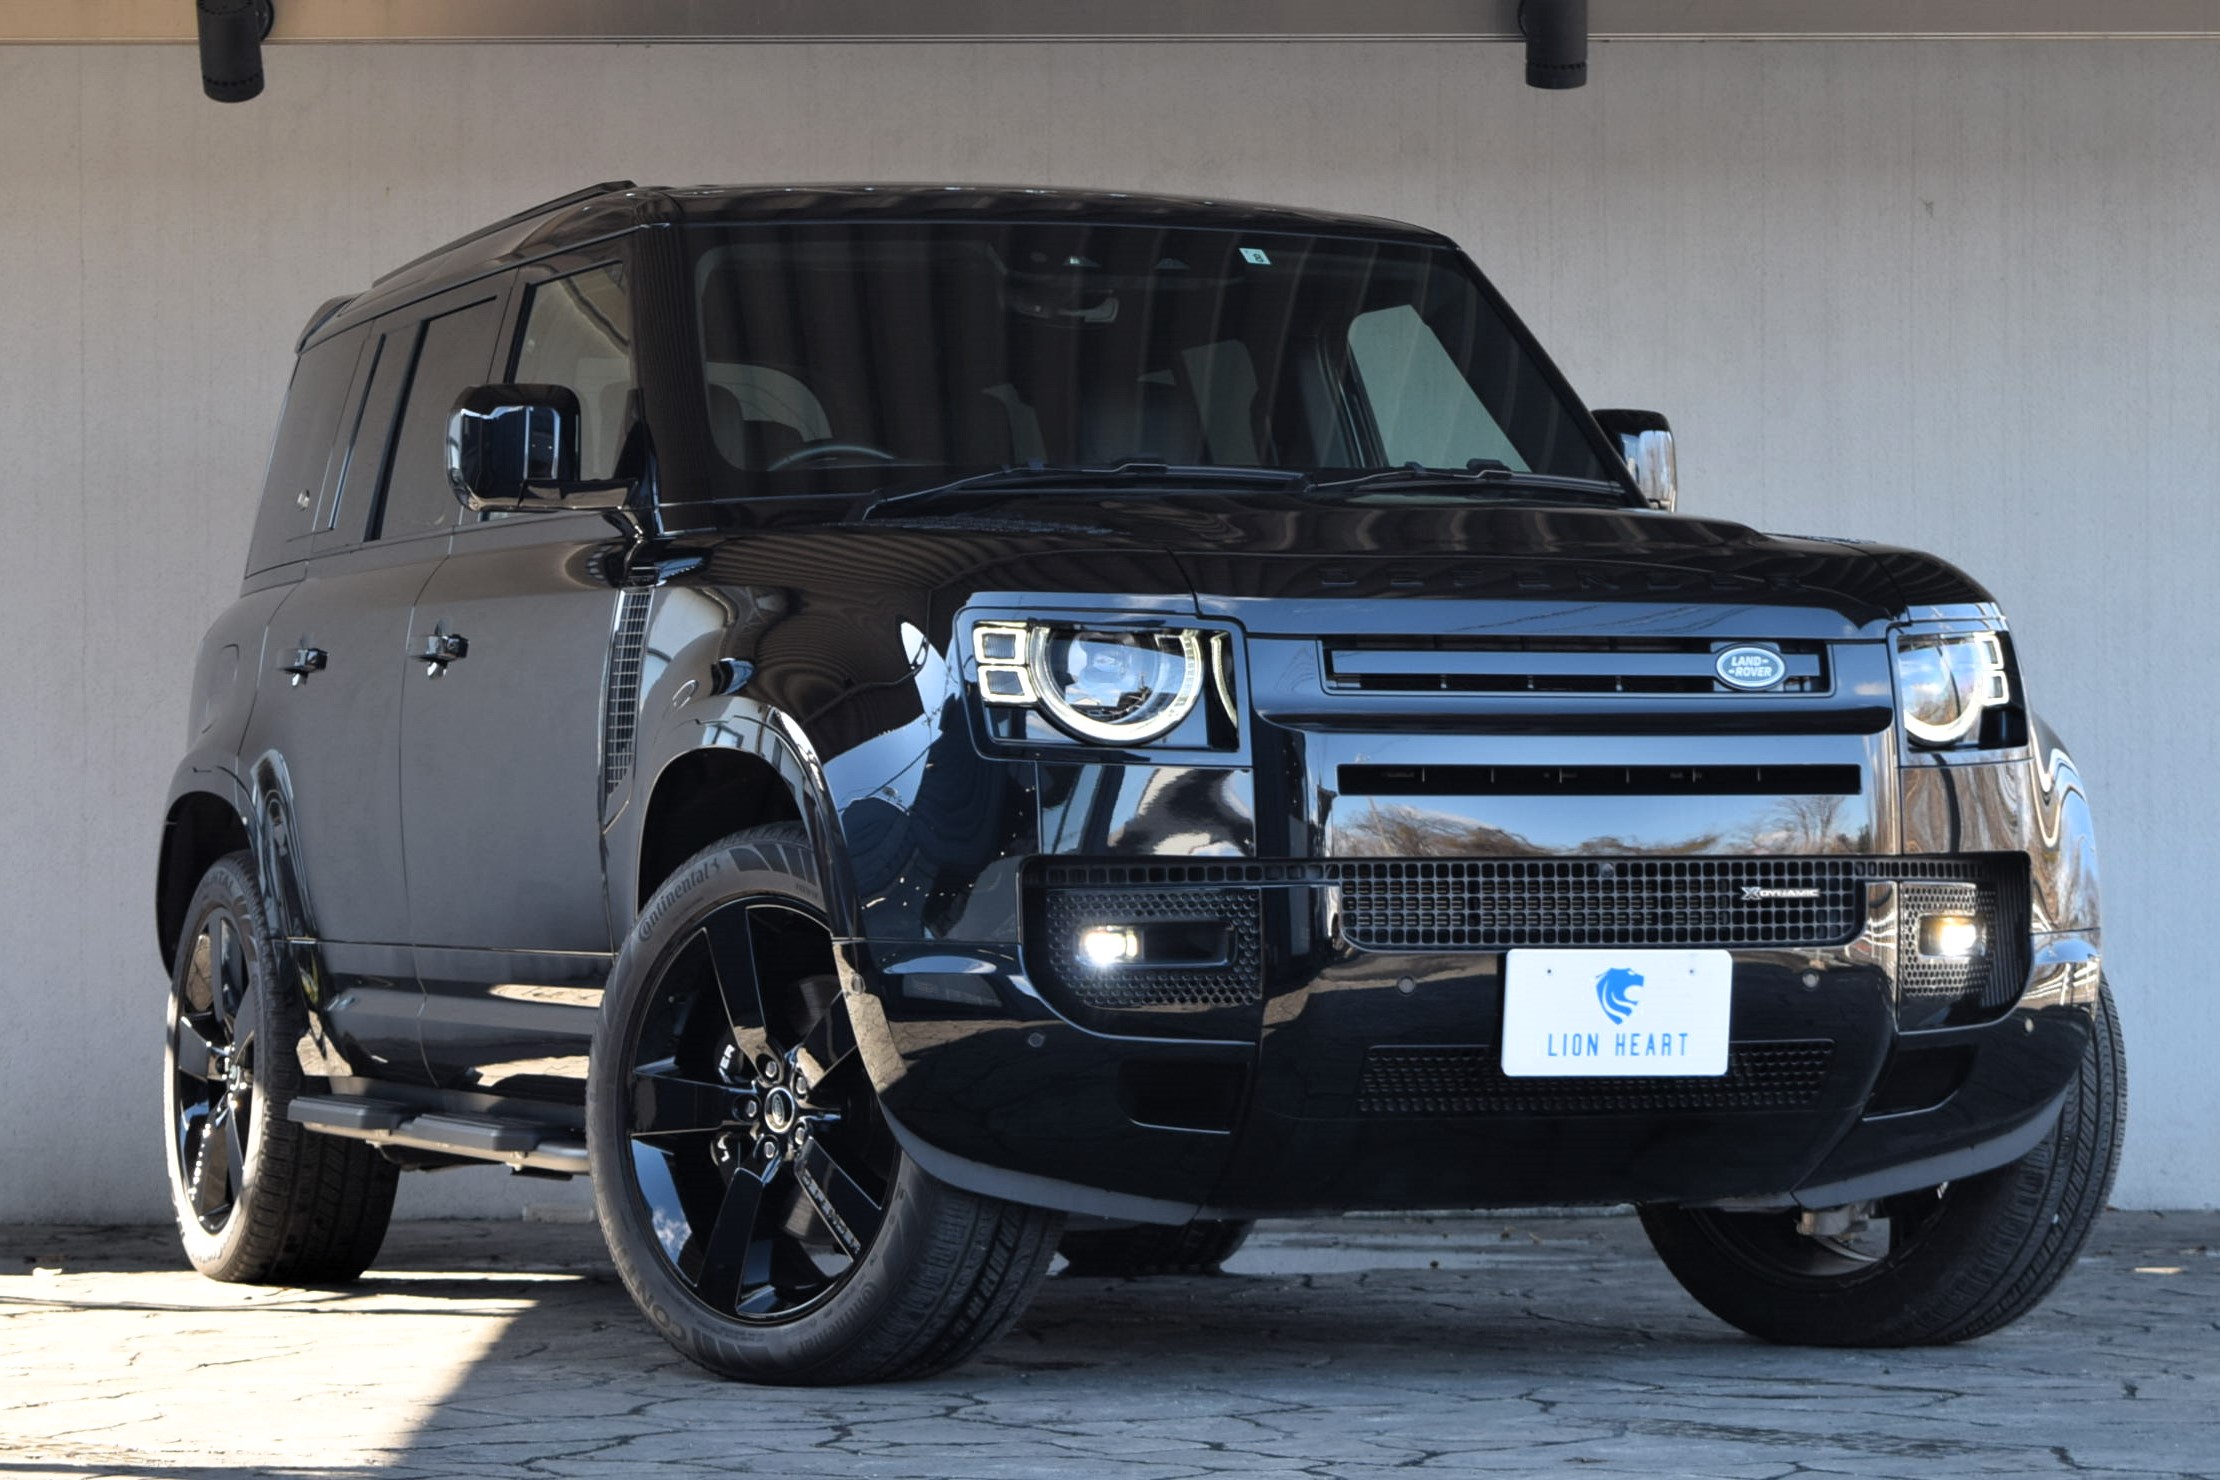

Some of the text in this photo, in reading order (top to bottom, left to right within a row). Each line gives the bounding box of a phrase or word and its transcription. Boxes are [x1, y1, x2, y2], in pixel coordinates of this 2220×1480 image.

[1731, 655, 1762, 667] LAND
[1734, 666, 1773, 677] ROVER
[638, 861, 710, 942] Continental
[1547, 1033, 1689, 1057] LION HEART
